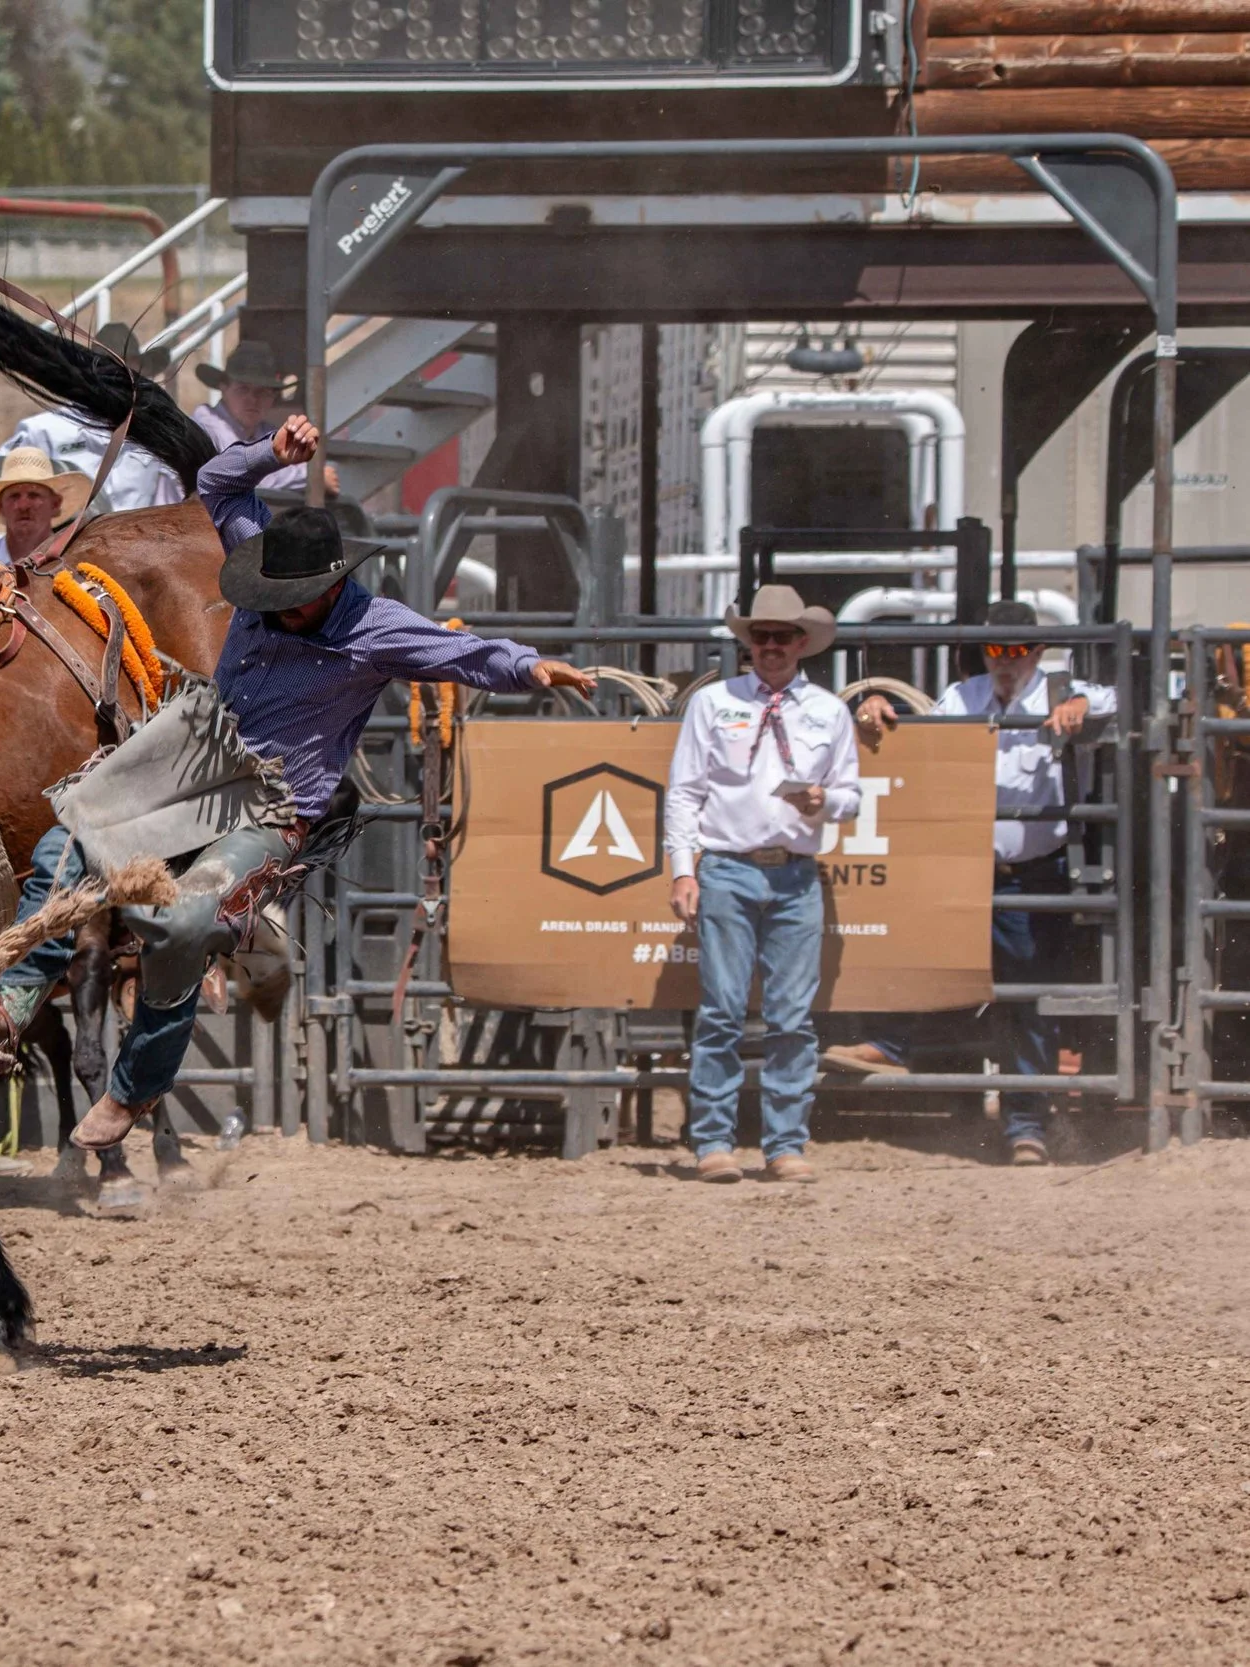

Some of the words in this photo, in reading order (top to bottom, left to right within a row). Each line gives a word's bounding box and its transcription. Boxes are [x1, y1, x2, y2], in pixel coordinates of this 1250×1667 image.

[337, 181, 407, 255] Priefert
[818, 863, 887, 886] ENTS
[541, 920, 583, 932] ARENA
[585, 921, 628, 933] DRAGS
[828, 924, 888, 935] TRAILERS
[633, 944, 699, 963] #ABe
